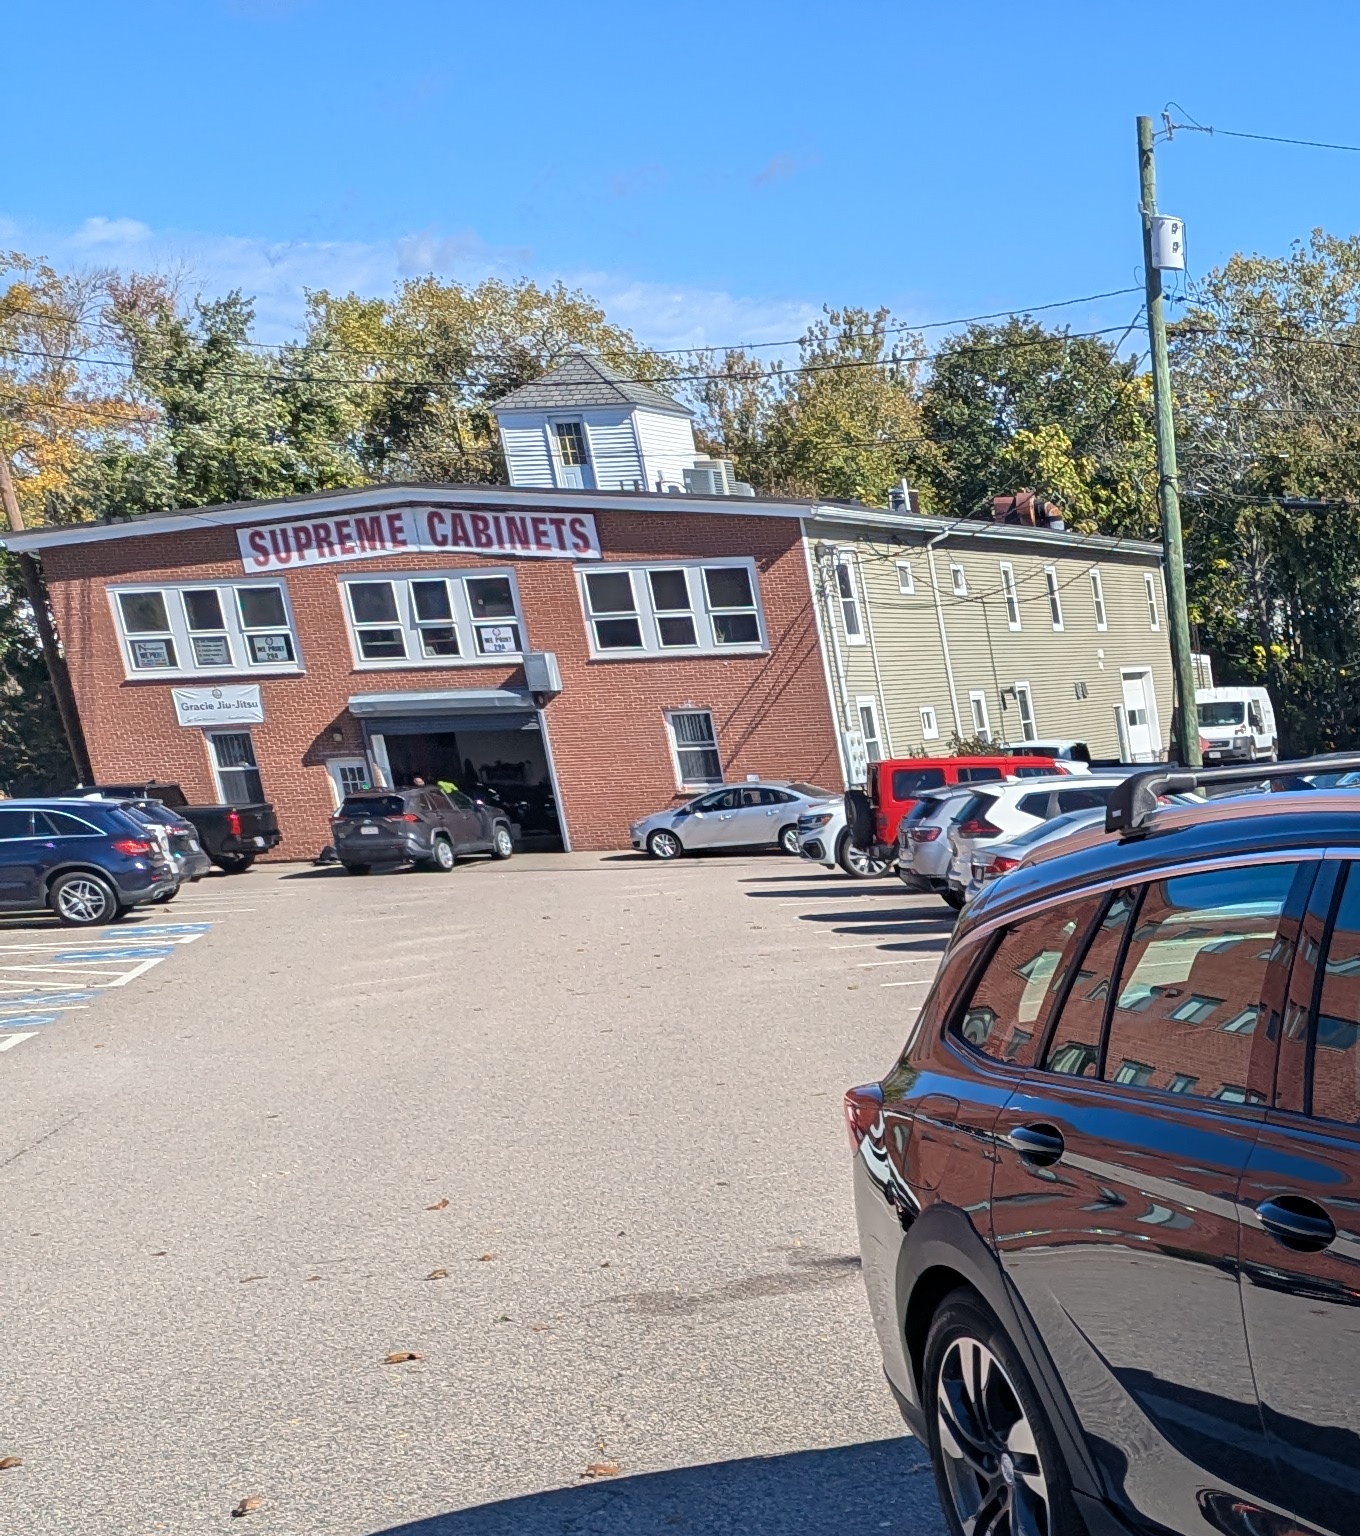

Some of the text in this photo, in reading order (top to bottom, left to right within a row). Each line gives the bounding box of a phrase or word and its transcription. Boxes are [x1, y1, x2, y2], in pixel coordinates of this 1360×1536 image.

[249, 511, 592, 566] SUPREME CABINETS
[181, 699, 259, 712] Gracie Jiu-Jitsu
